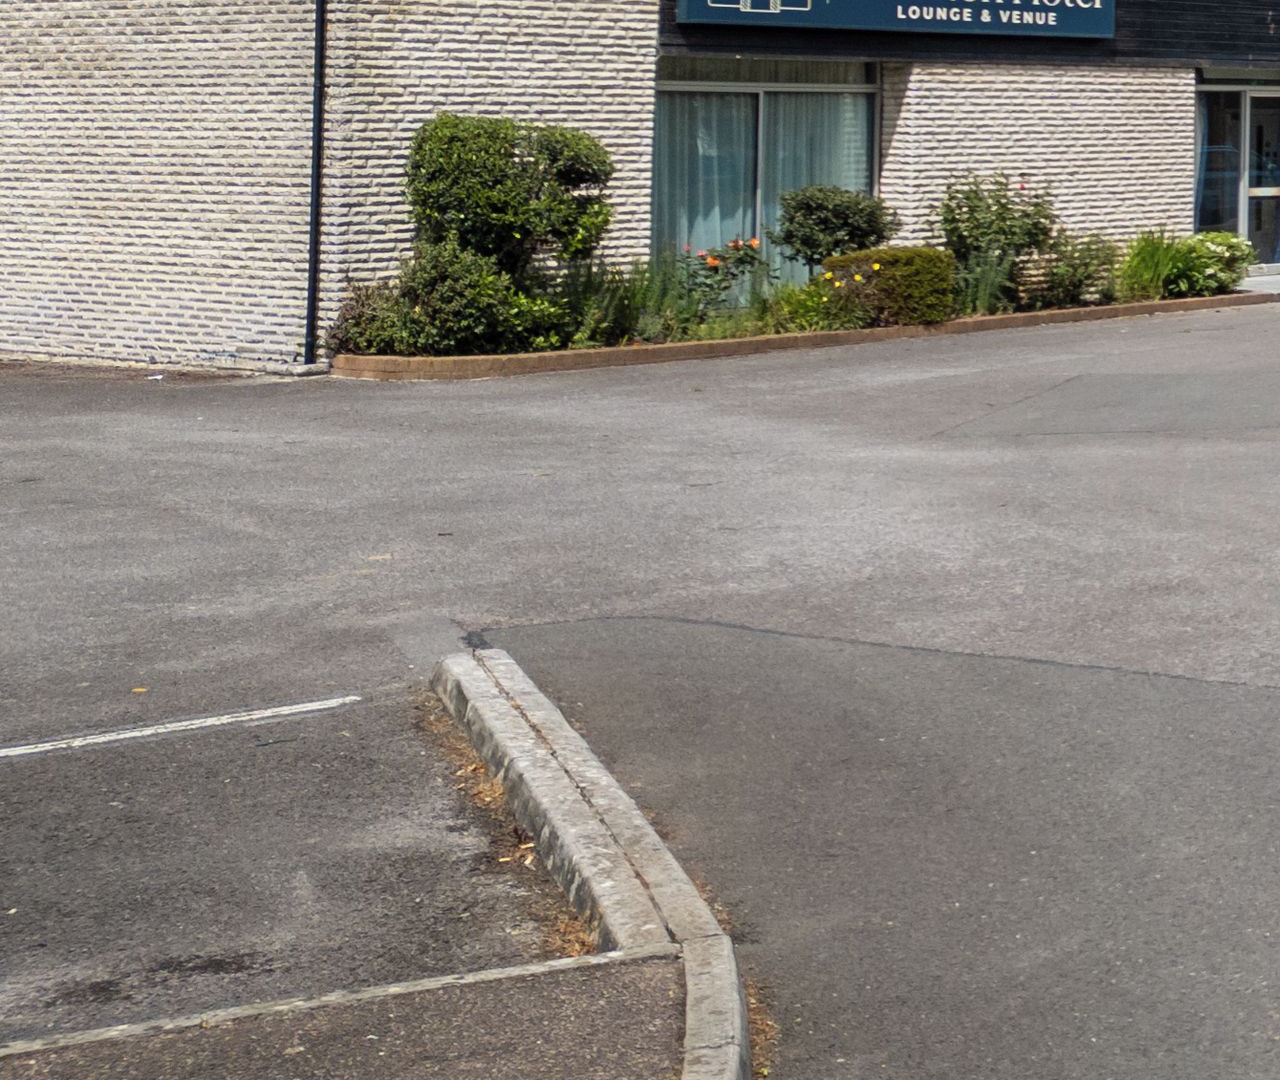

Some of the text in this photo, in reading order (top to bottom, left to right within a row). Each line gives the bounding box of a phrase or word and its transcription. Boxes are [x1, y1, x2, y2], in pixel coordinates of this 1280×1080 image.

[896, 5, 1057, 26] LOUNGE & VENUE
